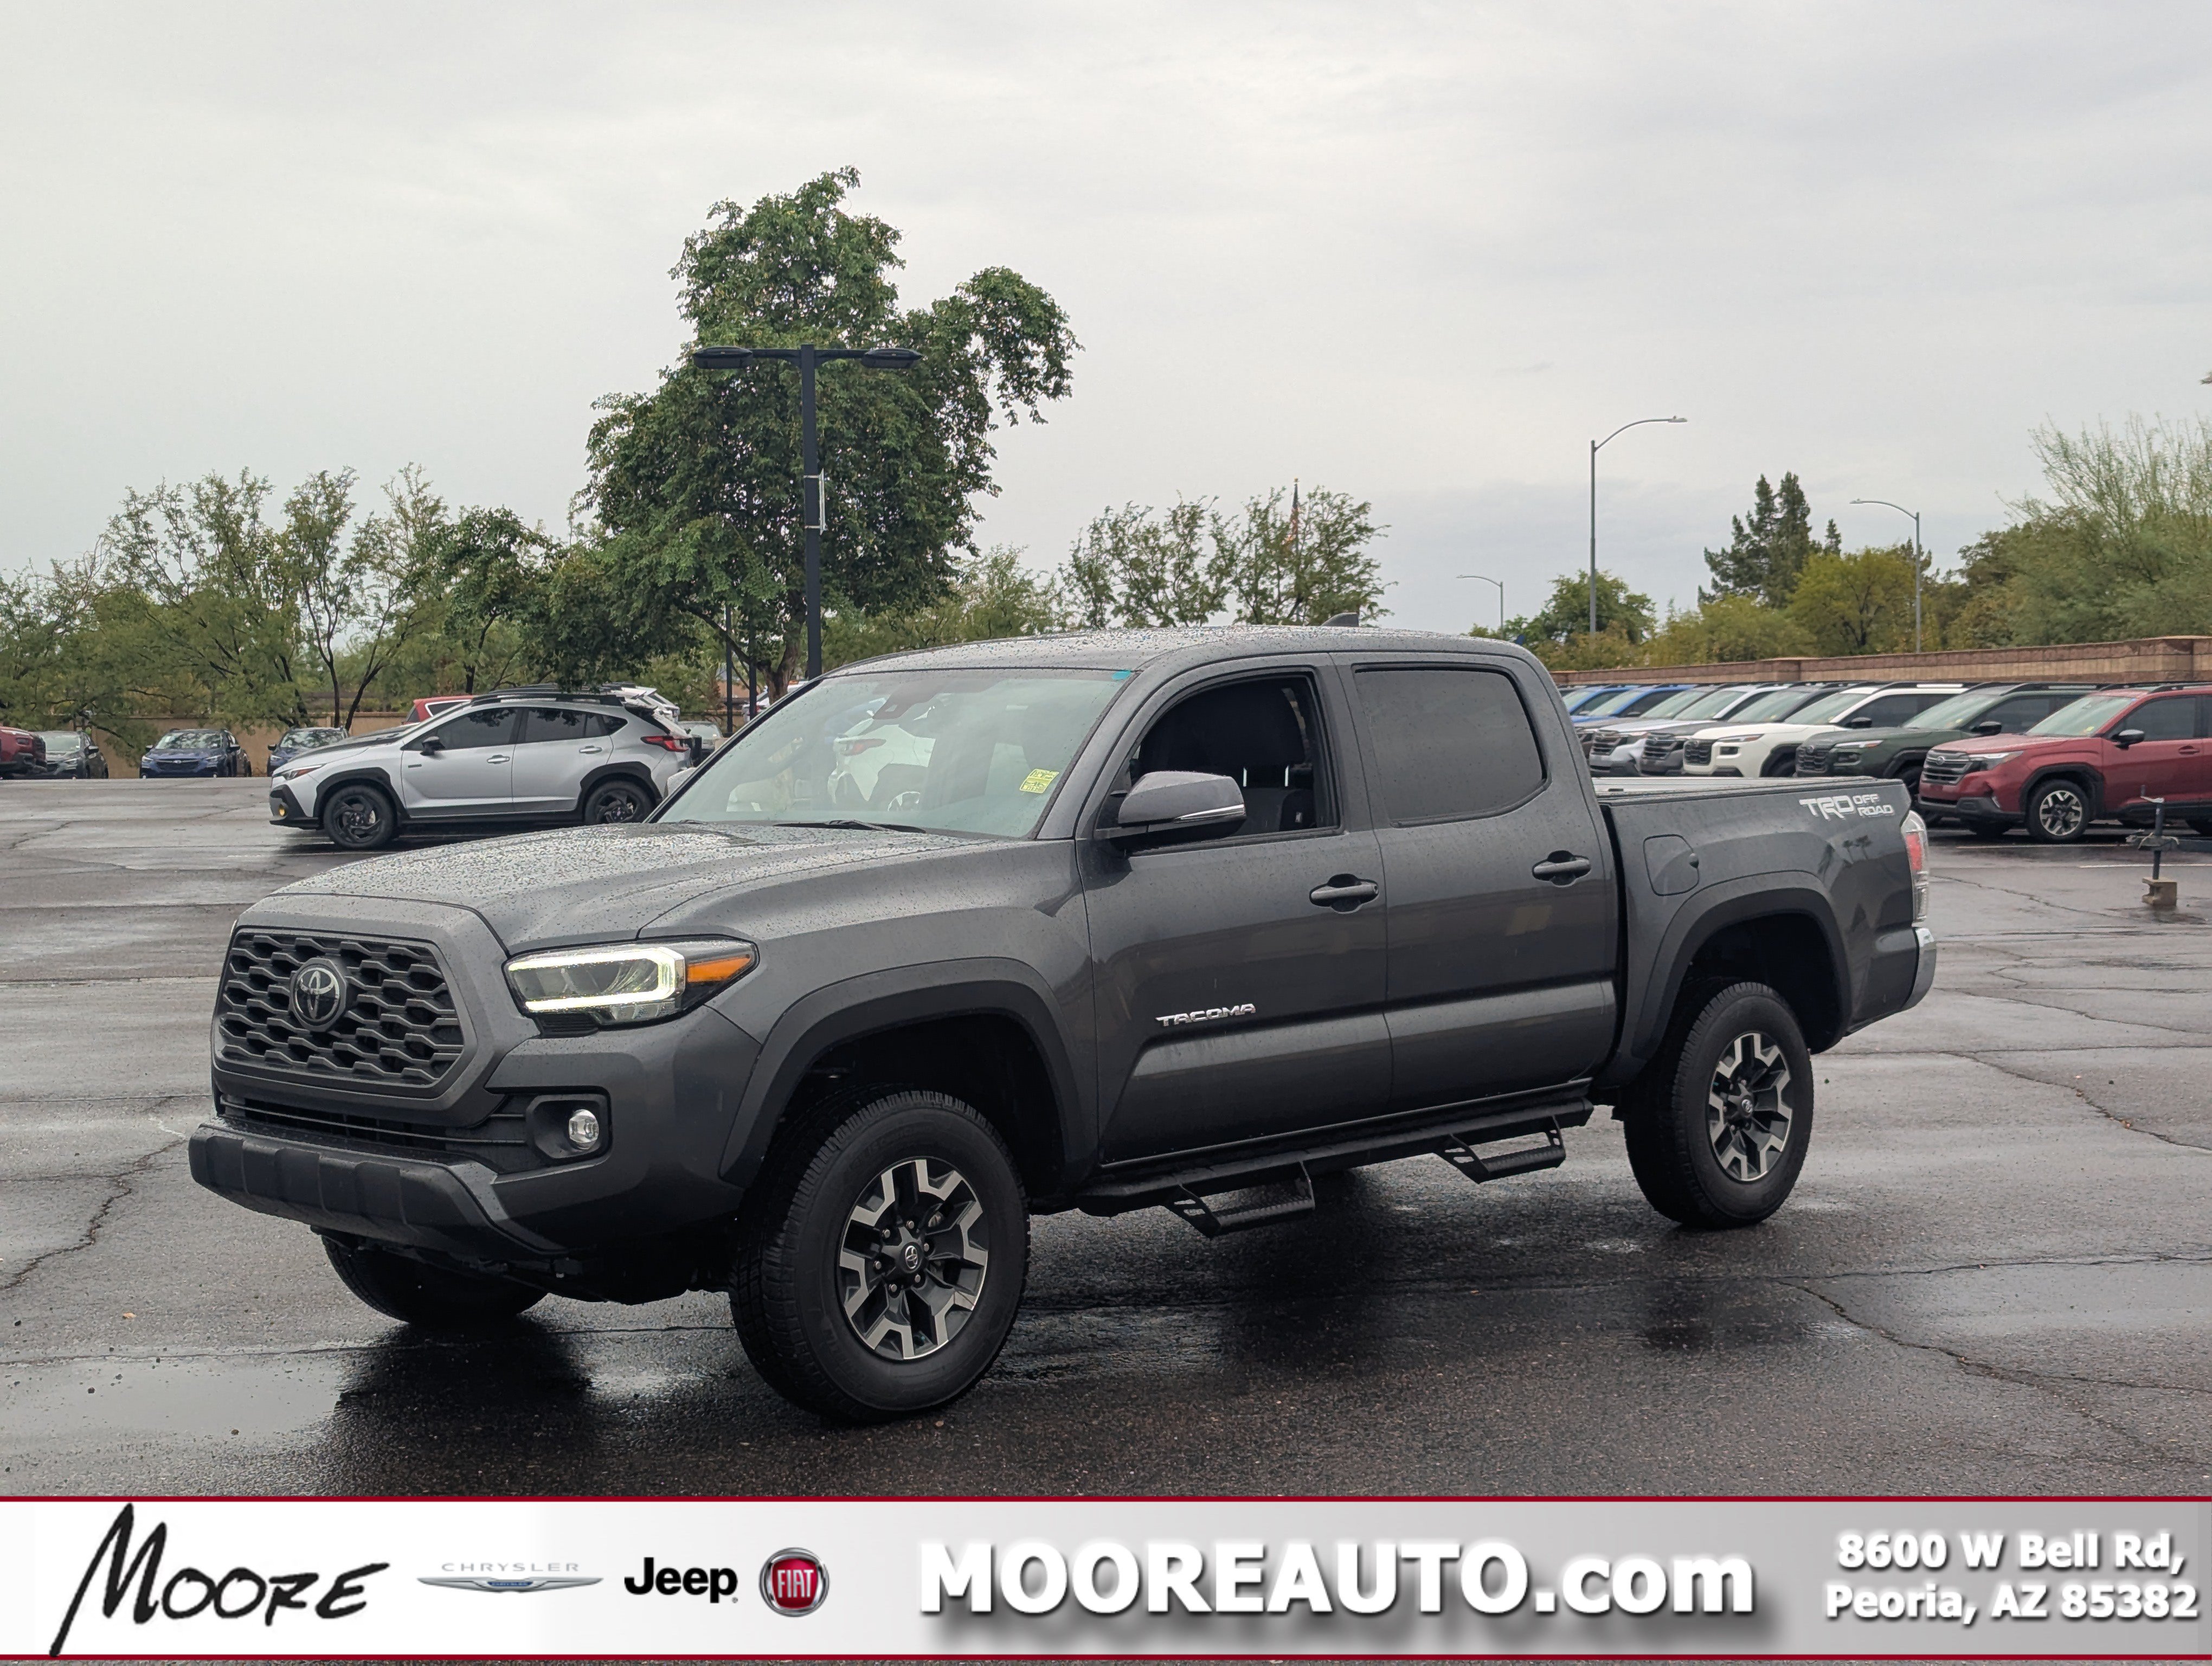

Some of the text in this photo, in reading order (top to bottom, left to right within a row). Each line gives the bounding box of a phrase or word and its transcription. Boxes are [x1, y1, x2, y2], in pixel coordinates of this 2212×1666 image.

[1799, 795, 1855, 821] TRD
[1852, 793, 1879, 805] OFF
[1857, 805, 1894, 817] ROAD
[1155, 1003, 1256, 1027] TACOMA
